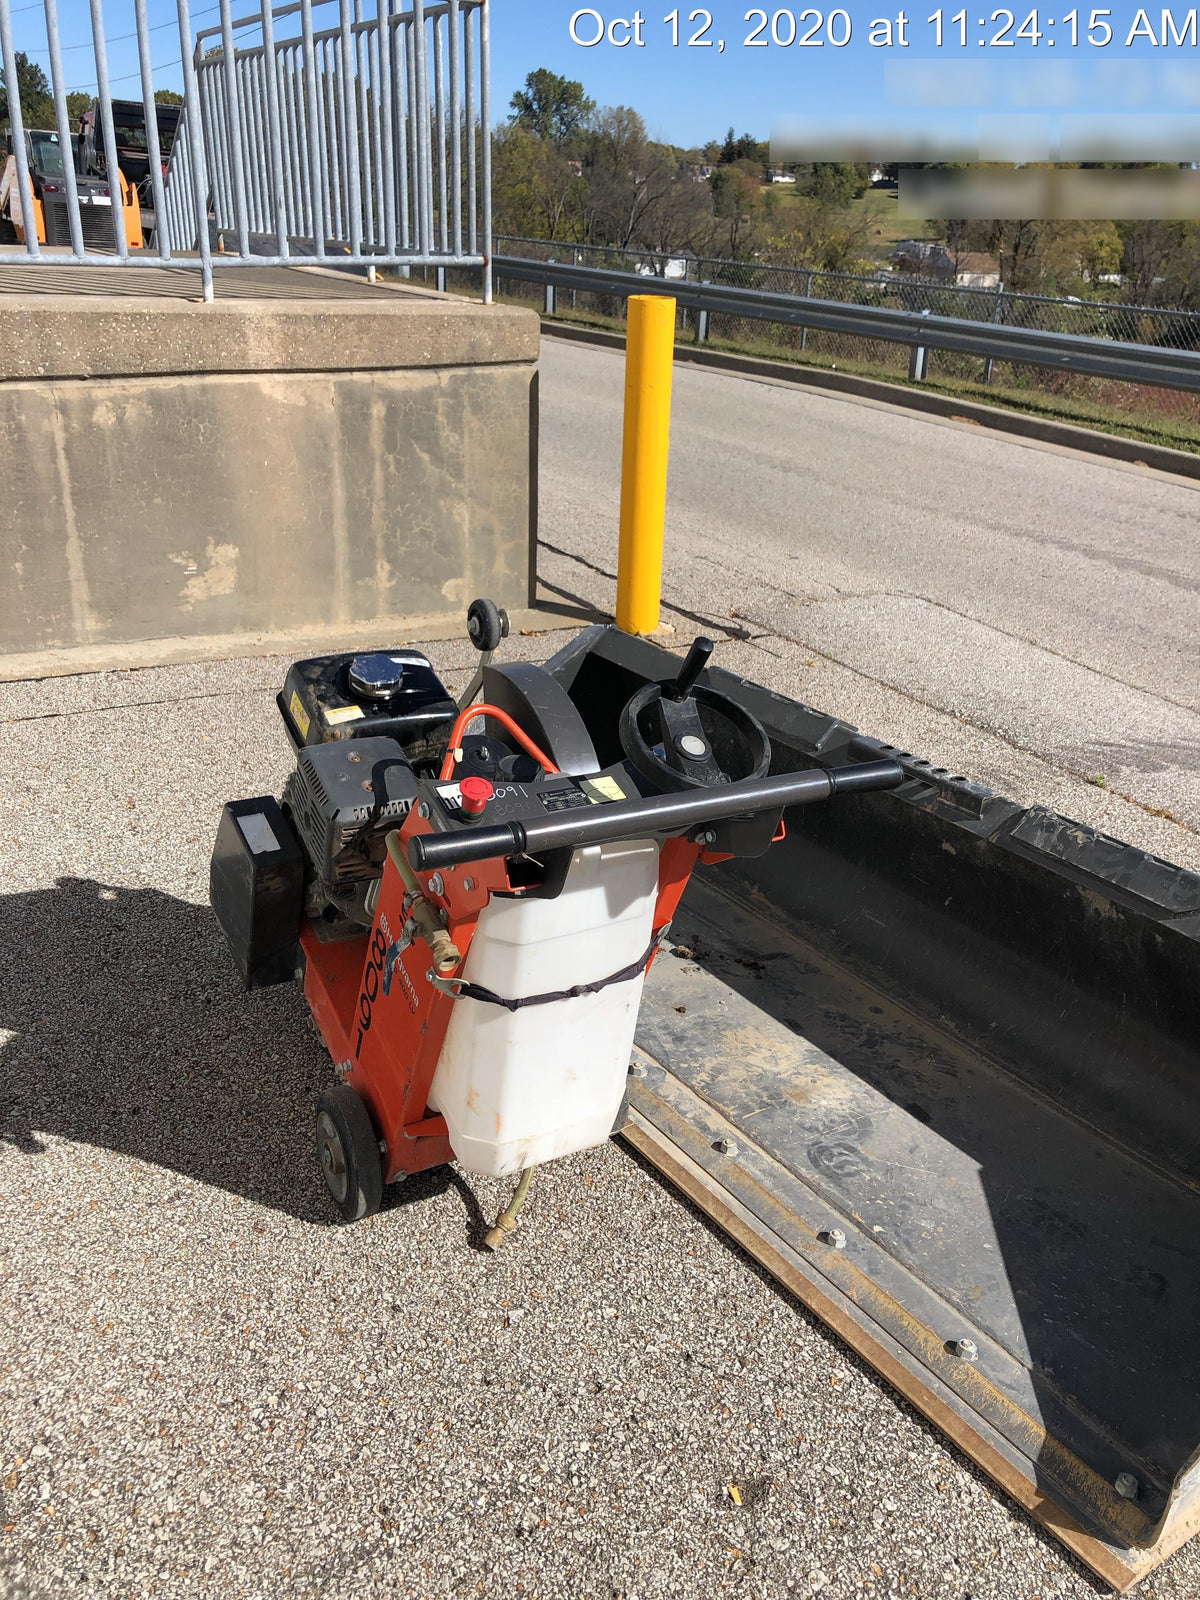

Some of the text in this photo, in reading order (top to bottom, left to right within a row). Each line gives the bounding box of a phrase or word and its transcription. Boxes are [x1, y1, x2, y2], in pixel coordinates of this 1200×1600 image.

[494, 802, 531, 816] 8091
[355, 927, 388, 1061] 8091
[385, 927, 420, 1008] Hqvarna
